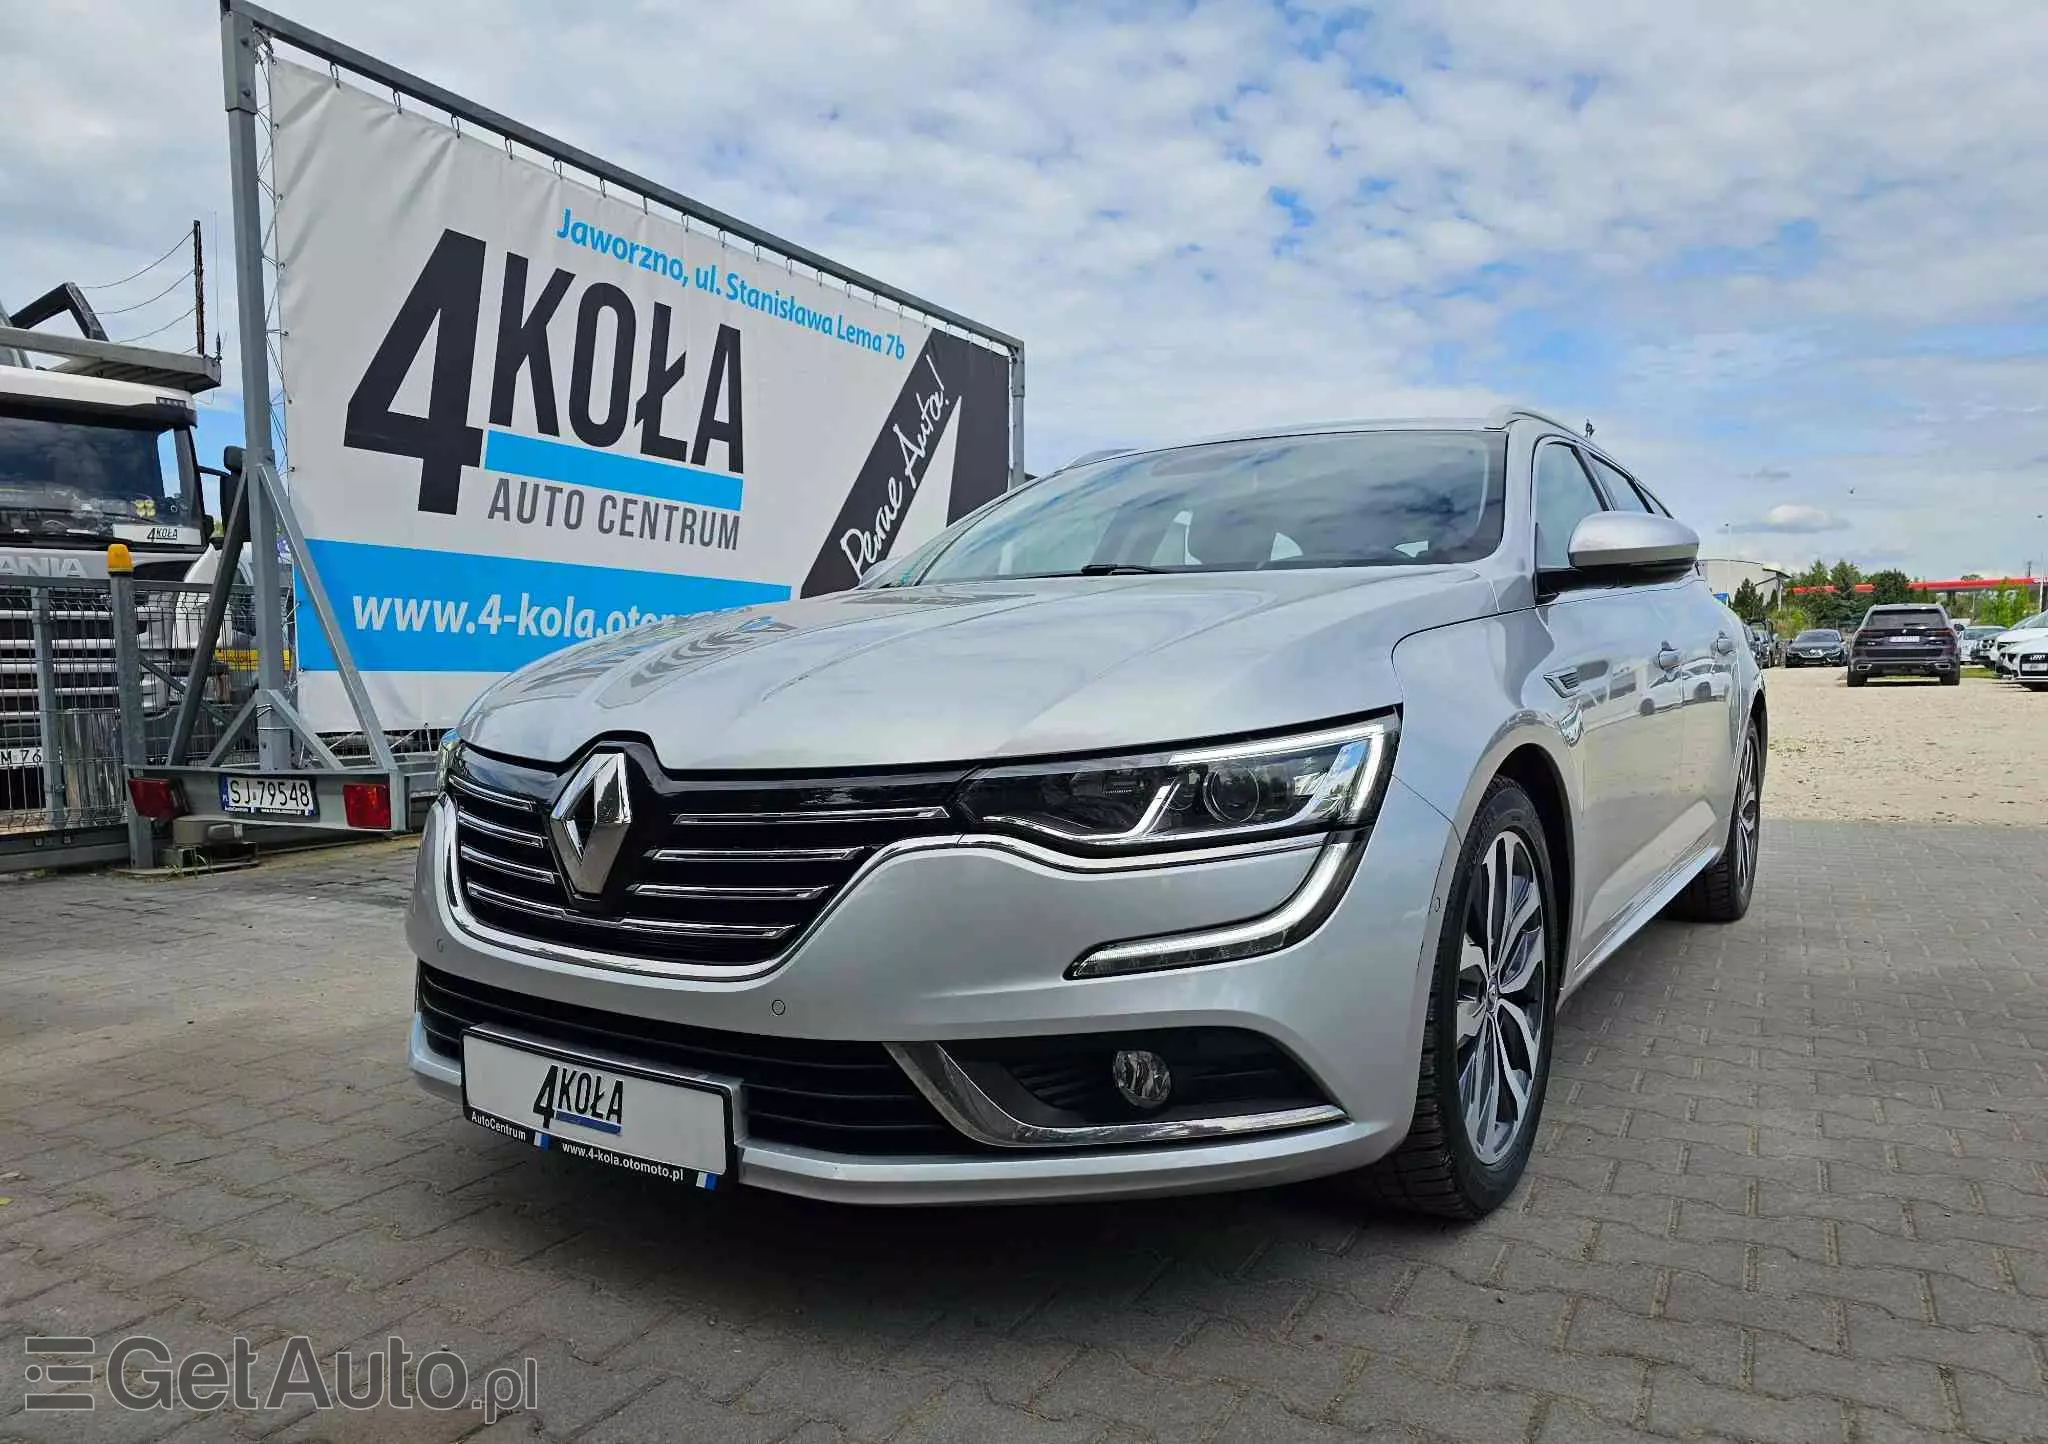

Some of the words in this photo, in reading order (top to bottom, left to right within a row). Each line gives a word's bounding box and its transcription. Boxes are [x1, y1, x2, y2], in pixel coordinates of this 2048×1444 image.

[555, 207, 689, 288] Jaworzno,
[695, 264, 721, 296] ul.
[726, 272, 834, 336] Stanisława
[837, 314, 882, 353] Lema
[886, 333, 905, 360] 7b
[892, 354, 950, 489] Auta!
[487, 477, 585, 530] AUTO
[597, 494, 741, 551] CENTRUM
[257, 781, 309, 807] 79548
[471, 1111, 527, 1142] AutoCentrum
[562, 1142, 685, 1182] www.4-kola.otomoto.pl
